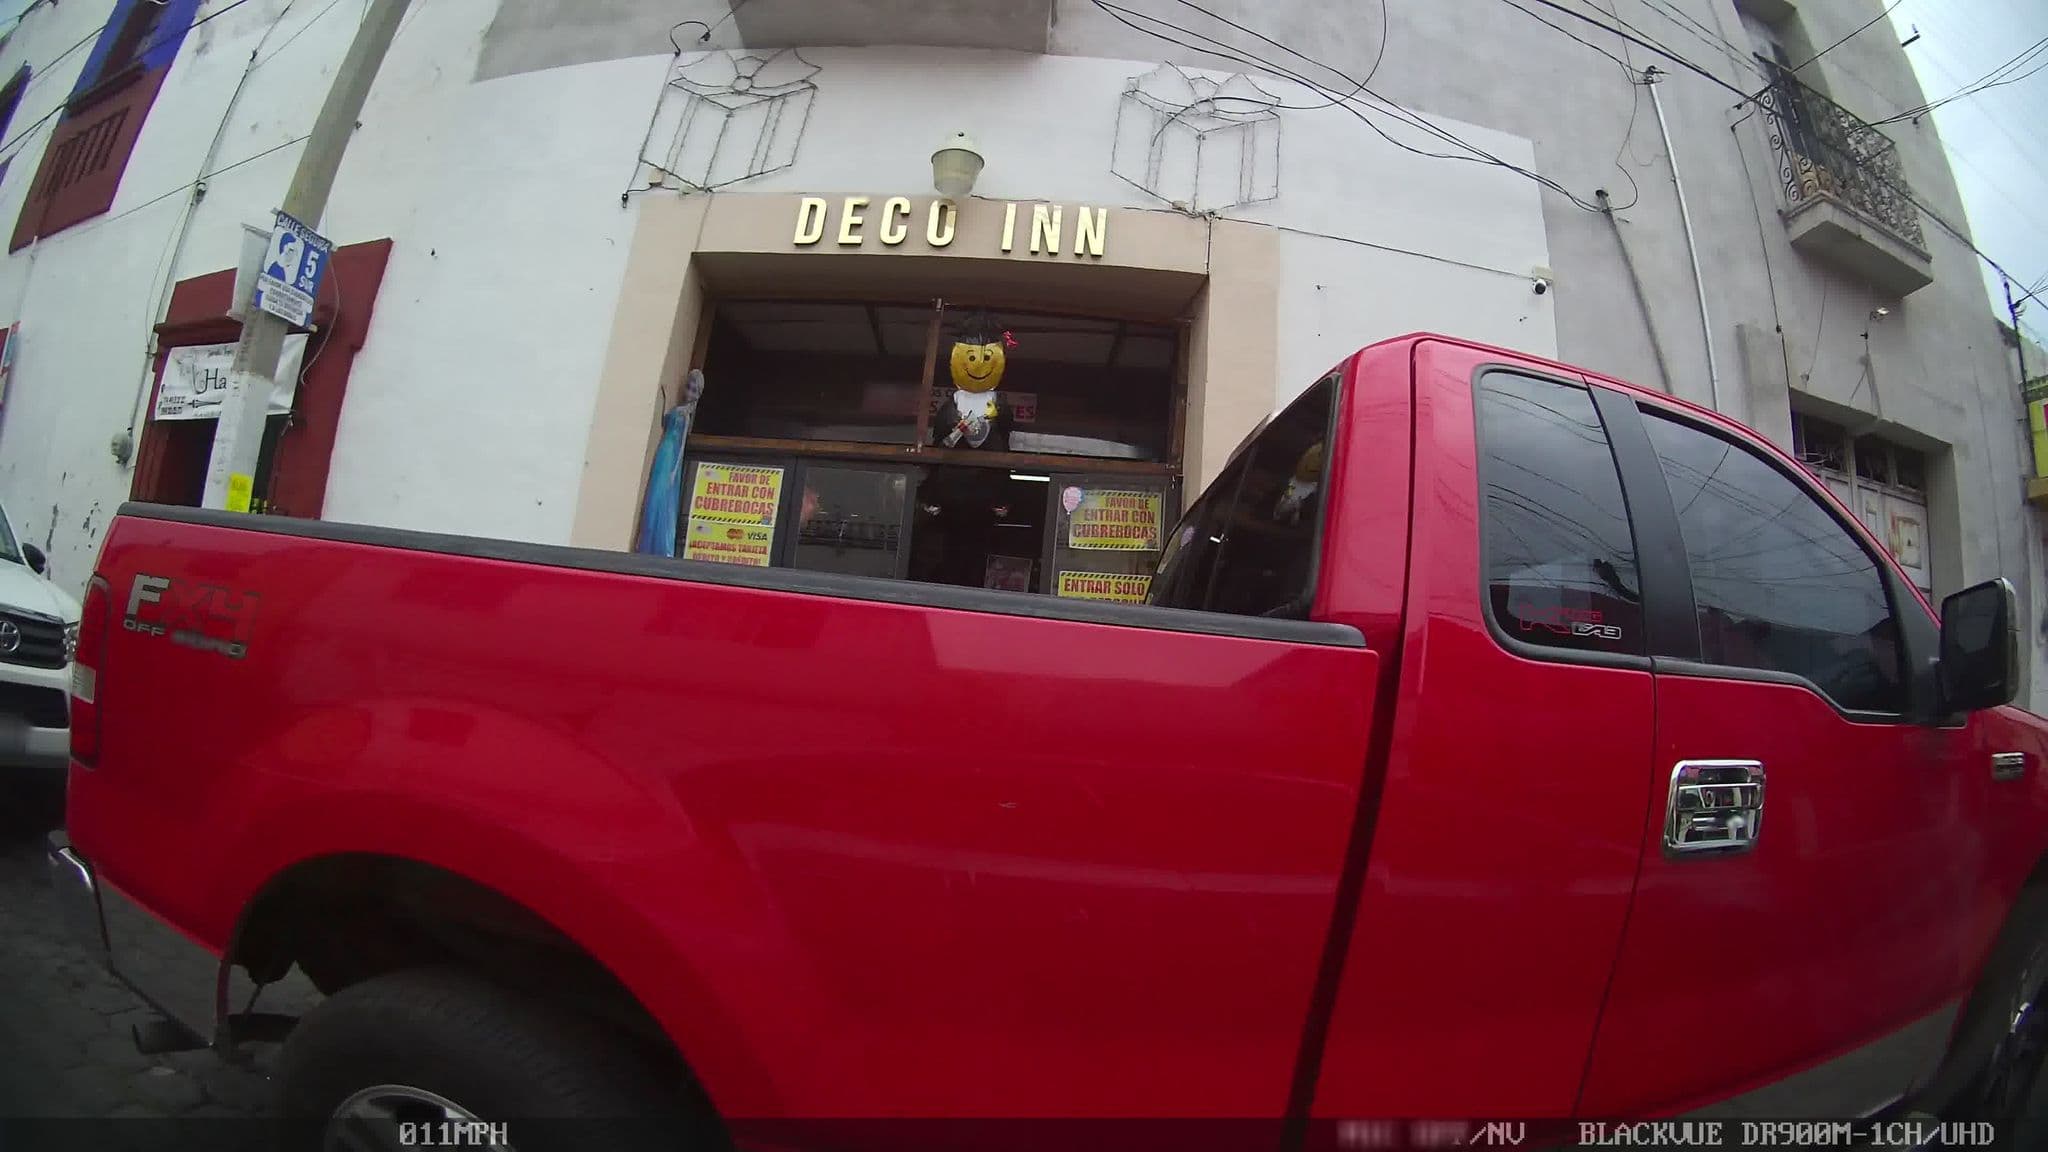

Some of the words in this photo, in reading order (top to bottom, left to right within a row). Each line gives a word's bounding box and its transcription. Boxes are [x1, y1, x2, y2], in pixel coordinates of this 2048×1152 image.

[278, 214, 301, 237] CALLE
[299, 228, 330, 252] SEGURA
[793, 196, 957, 247] DECO
[1001, 203, 1107, 256] INN
[305, 250, 319, 278] 5
[729, 472, 758, 485] FAVOR
[760, 474, 770, 485] DE
[707, 482, 749, 498] ENTRAR
[752, 486, 775, 499] CON
[695, 496, 774, 515] CUBREBOCAS
[1106, 497, 1135, 510] FAVOR
[1138, 499, 1149, 510] DE
[1084, 508, 1128, 522] ENTRAR
[1132, 510, 1155, 523] CON
[748, 532, 767, 541] VISA
[1073, 523, 1157, 540] CUBREBOCAS
[738, 544, 768, 556] TARJETA
[1064, 579, 1111, 594] ENTRAR
[1115, 581, 1145, 596] SOLO
[123, 619, 166, 636] OFF
